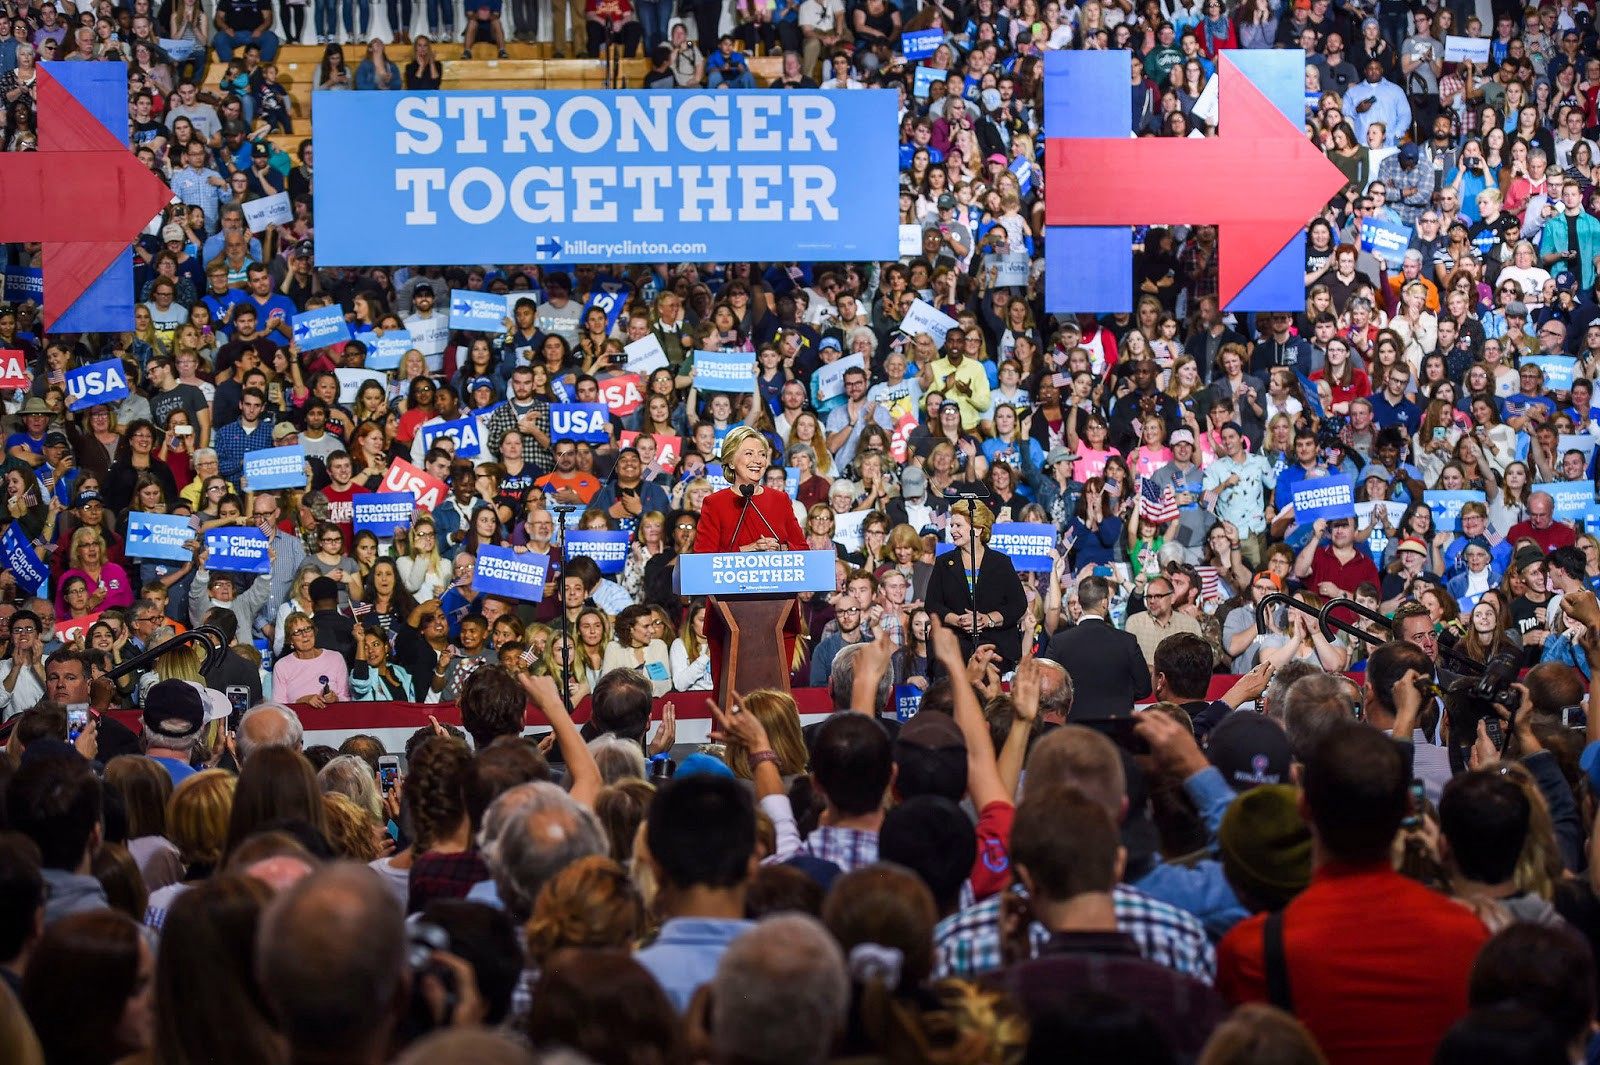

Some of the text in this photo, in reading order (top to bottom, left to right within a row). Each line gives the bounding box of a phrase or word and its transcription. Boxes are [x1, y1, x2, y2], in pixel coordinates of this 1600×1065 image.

[395, 94, 838, 155] STRONGER
[395, 164, 839, 225] TOGETHER
[1376, 228, 1408, 246] Clinton
[564, 240, 707, 258] hillaryclinton.com
[472, 301, 506, 312] Clinton
[309, 314, 343, 329] Clinton
[472, 310, 499, 320] Kaine
[311, 324, 339, 337] Kaine
[377, 338, 411, 348] Clinton
[697, 360, 753, 372] STRONGER
[697, 369, 753, 379] TOGETHER
[68, 367, 126, 399] USA
[552, 410, 606, 434] USA
[246, 455, 302, 469] STRONGER
[246, 463, 302, 477] TOGETHER
[386, 465, 440, 510] USA
[1294, 484, 1351, 502] STRONGER
[1295, 494, 1352, 511] TOGETHER
[1556, 491, 1593, 501] Clinton
[356, 502, 413, 514] STRONGER
[1557, 500, 1587, 511] Kaine
[152, 524, 194, 537] Clinton
[152, 535, 184, 546] Kaine
[231, 536, 269, 548] Clinton
[567, 541, 626, 551] STRONGER
[989, 534, 1053, 546] STRONGER
[231, 546, 262, 558] Kaine
[9, 553, 32, 581] Kaine
[14, 547, 42, 582] Clinton
[479, 555, 545, 576] STRONGER
[712, 553, 805, 569] STRONGER
[478, 565, 543, 587] TOGETHER
[712, 569, 806, 584] TOGETHER
